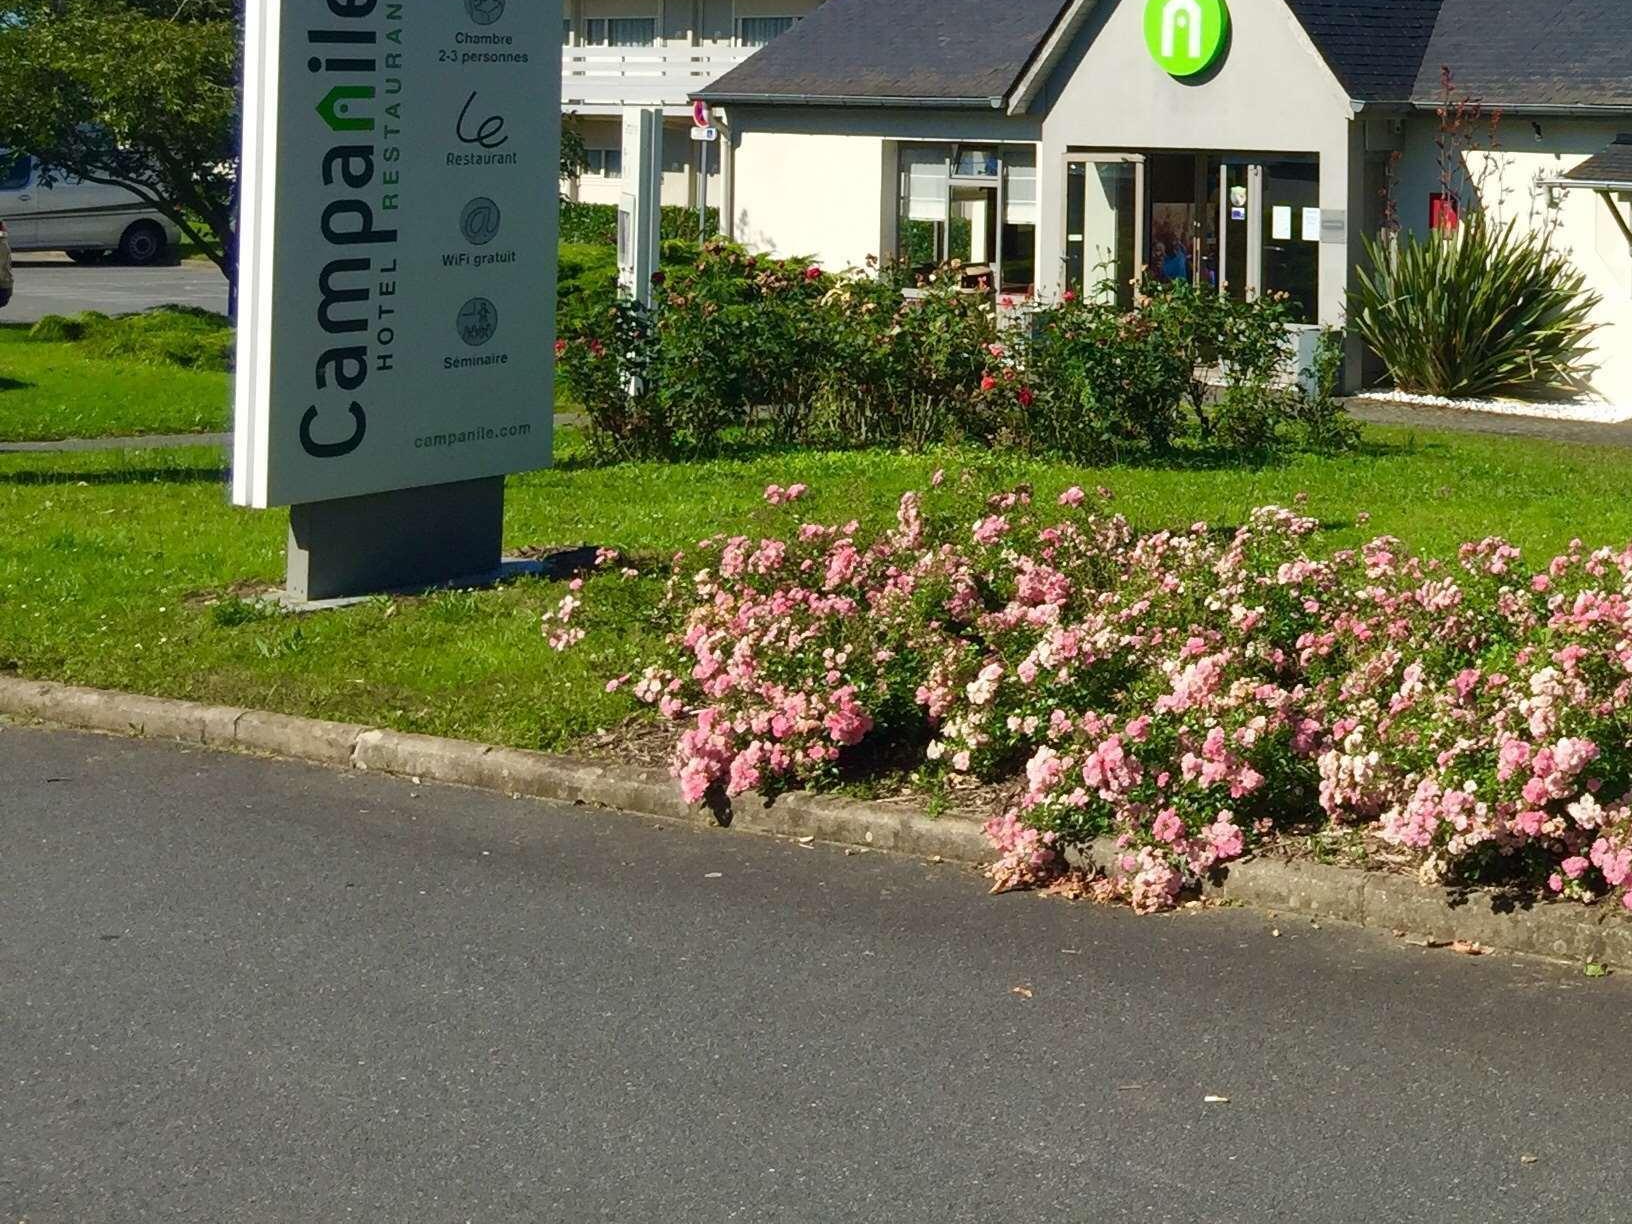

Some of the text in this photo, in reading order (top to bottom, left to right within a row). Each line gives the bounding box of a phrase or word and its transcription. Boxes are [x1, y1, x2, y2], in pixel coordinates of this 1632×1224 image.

[455, 32, 513, 45] Chambre
[439, 49, 529, 64] 2-3 personnes
[446, 152, 517, 166] Restaurant
[442, 251, 516, 267] WiFi gratuit
[376, 258, 398, 372] HOTEL
[414, 422, 532, 448] campanile.com
